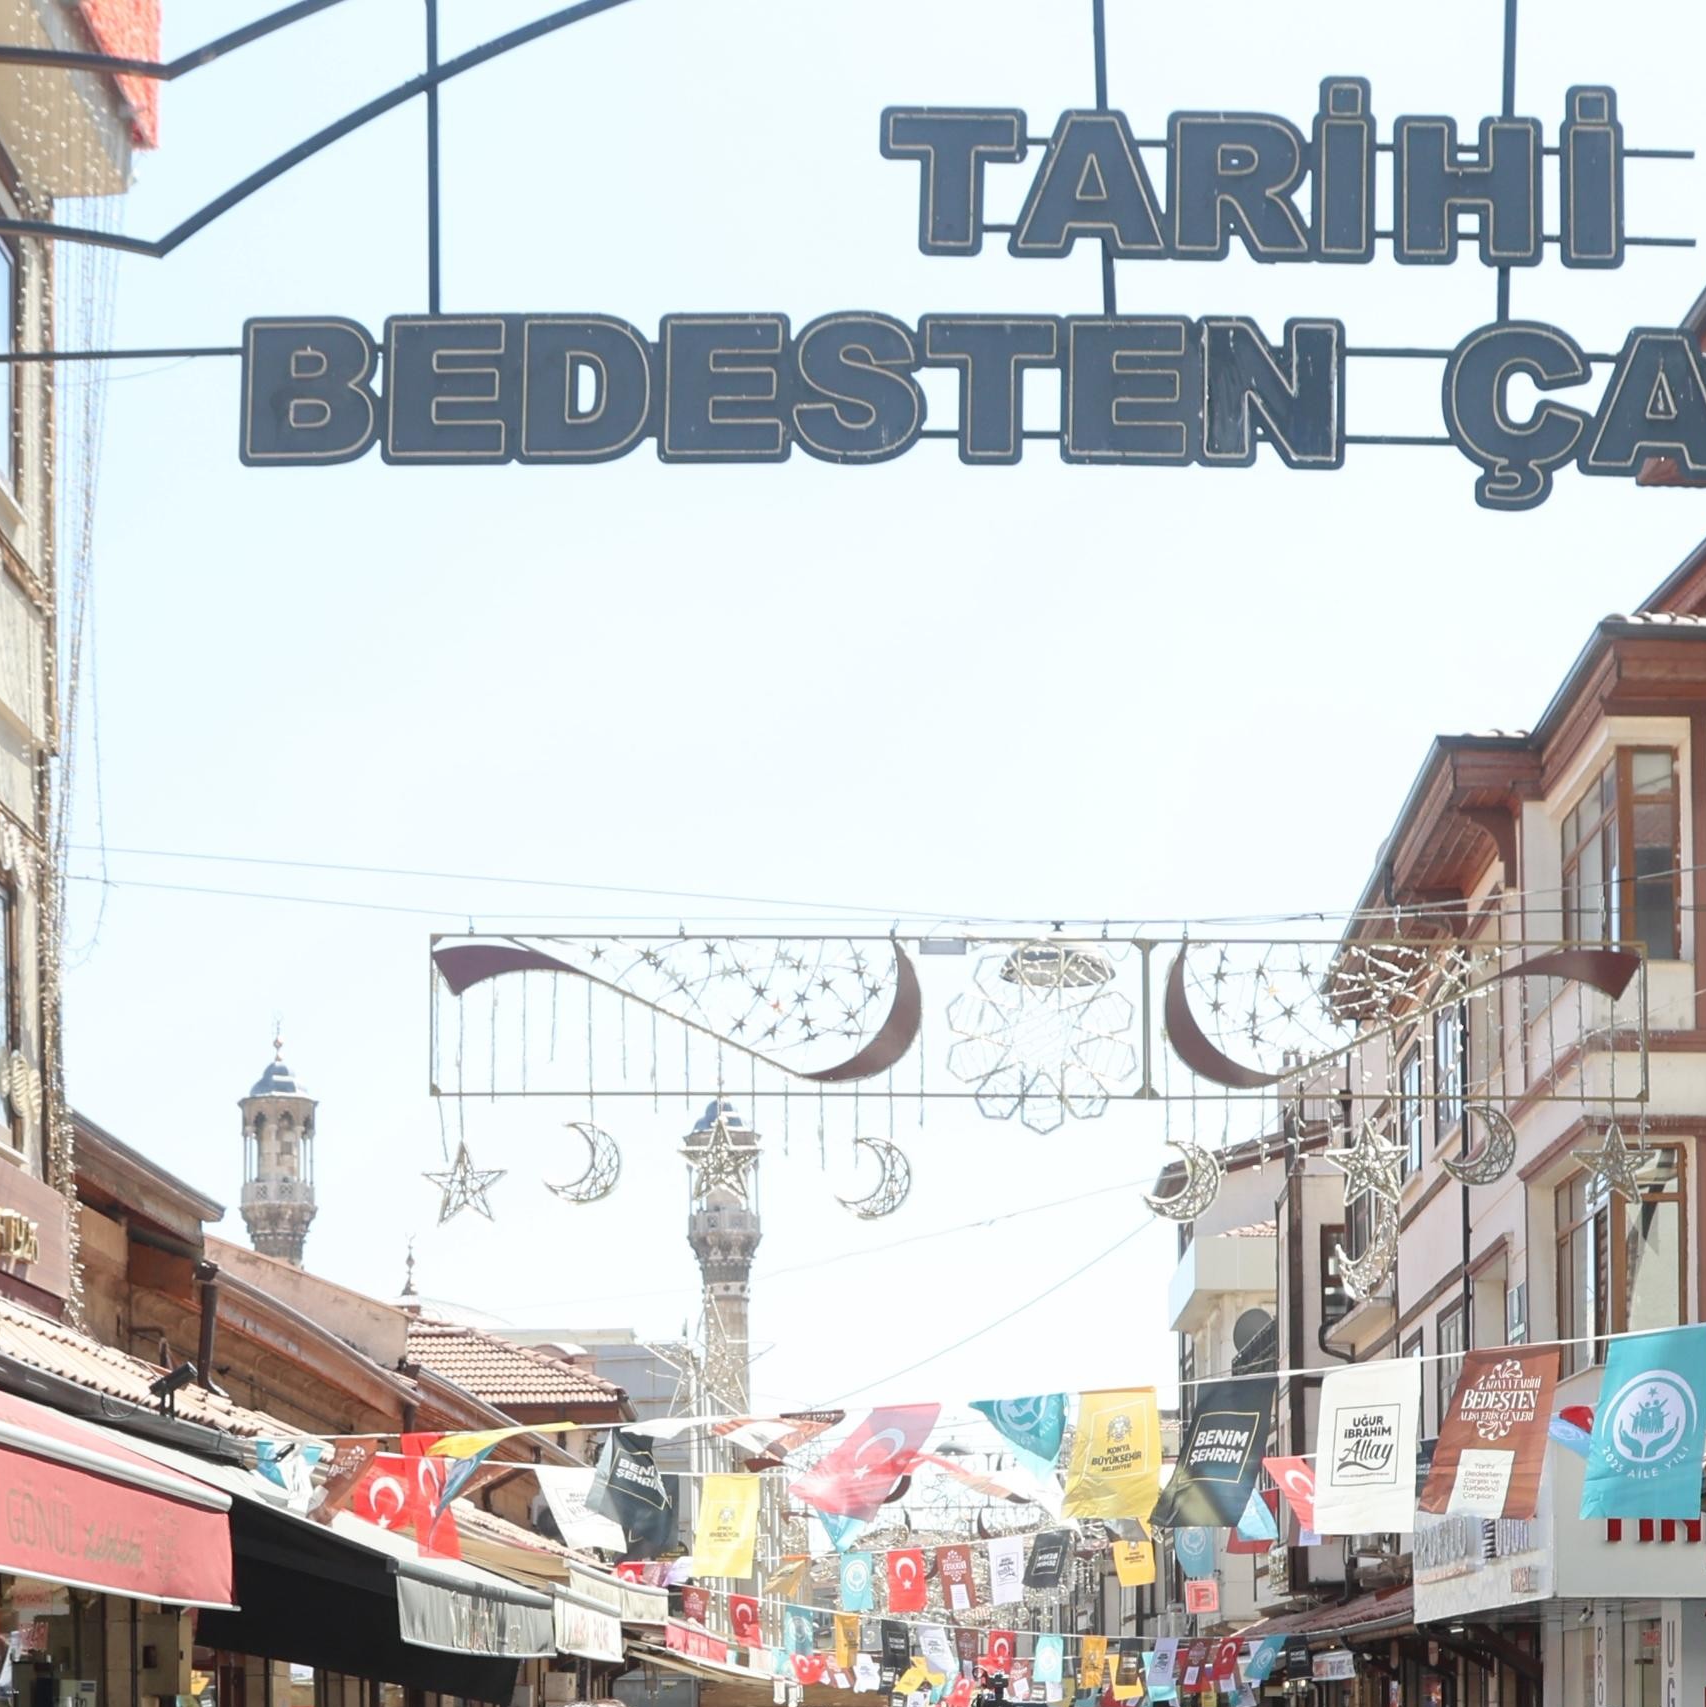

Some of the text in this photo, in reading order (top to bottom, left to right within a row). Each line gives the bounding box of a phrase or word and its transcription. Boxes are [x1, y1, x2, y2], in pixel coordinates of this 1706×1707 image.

[880, 76, 1625, 270] TARİHİ
[239, 310, 1345, 470] BEDESTEN
[1460, 1389, 1539, 1411] BEDESTEN
[1353, 1413, 1384, 1428] UĞUR
[1196, 1429, 1249, 1448] BENİM
[1344, 1426, 1392, 1439] İBRAHİM
[1091, 1450, 1143, 1467] BÜYÜKŞEHİR
[1106, 1443, 1131, 1456] KONYA
[1190, 1446, 1244, 1466] ŞEHRİM
[1337, 1439, 1394, 1471] Altay
[618, 1457, 656, 1478] BENİ
[1602, 1446, 1624, 1473] 2025
[1627, 1467, 1659, 1479] AİLE
[5, 1479, 77, 1557] GÖNÜL
